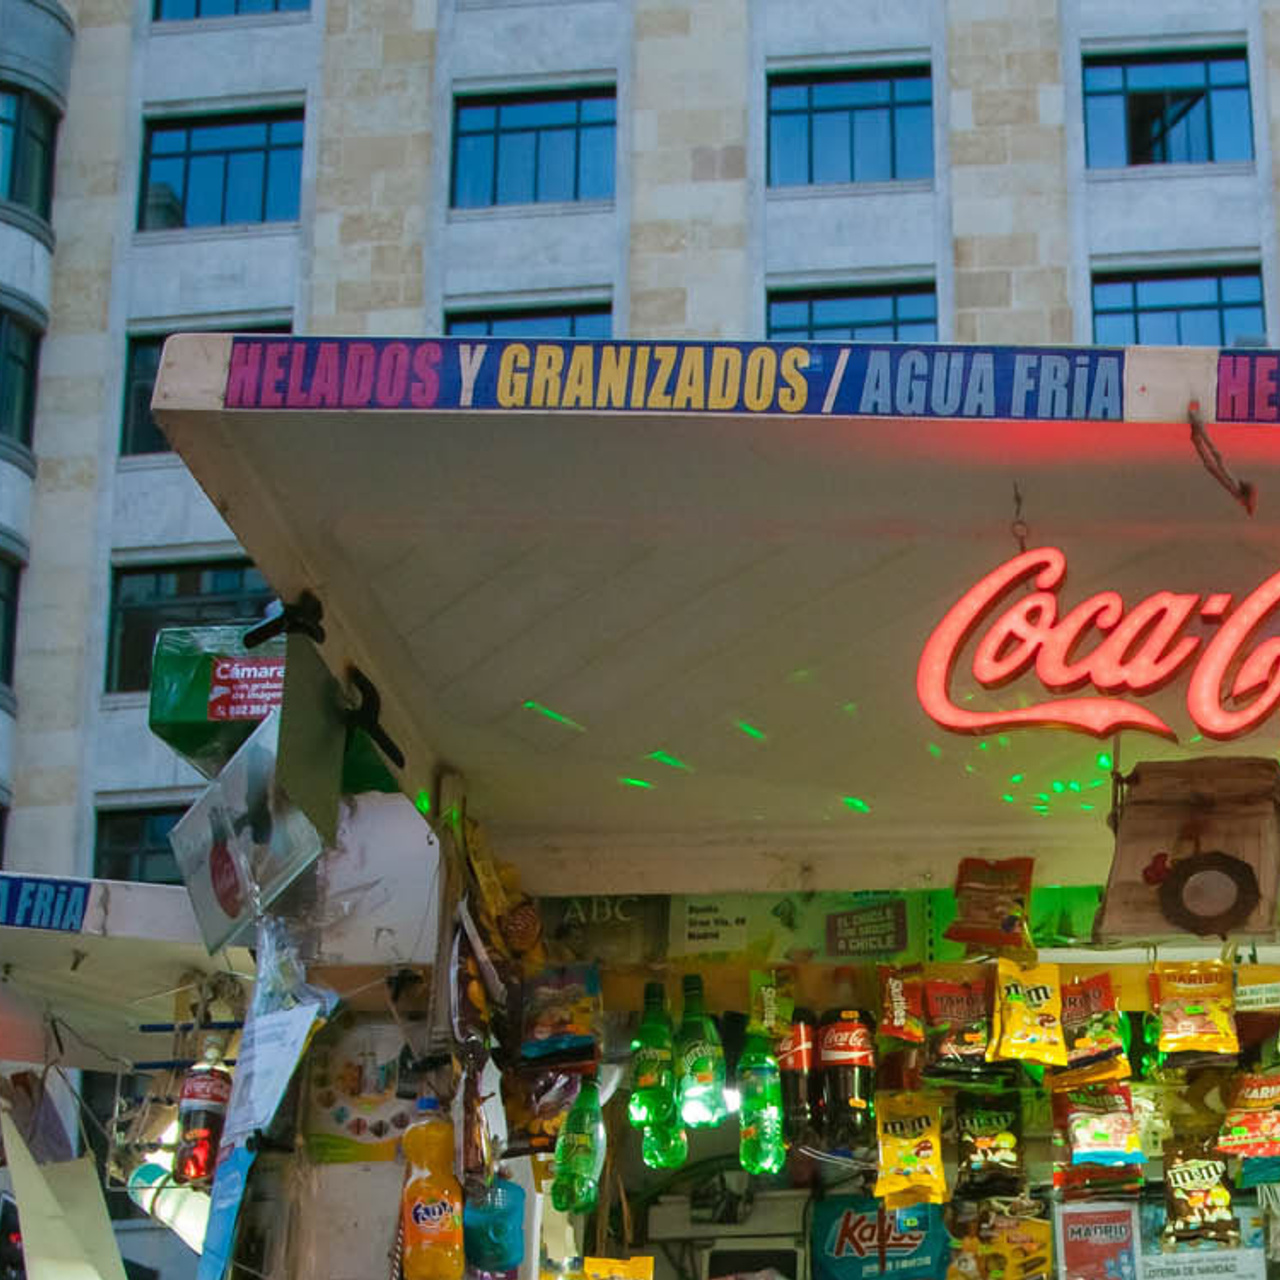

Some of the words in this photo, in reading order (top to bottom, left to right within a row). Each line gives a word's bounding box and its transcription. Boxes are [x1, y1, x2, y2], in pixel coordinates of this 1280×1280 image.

[227, 341, 441, 409] HELADOS
[457, 345, 481, 407] Y
[496, 345, 809, 412] GRANIZADOS
[859, 349, 995, 418] AGUA
[1068, 1225, 1129, 1239] MADRID
